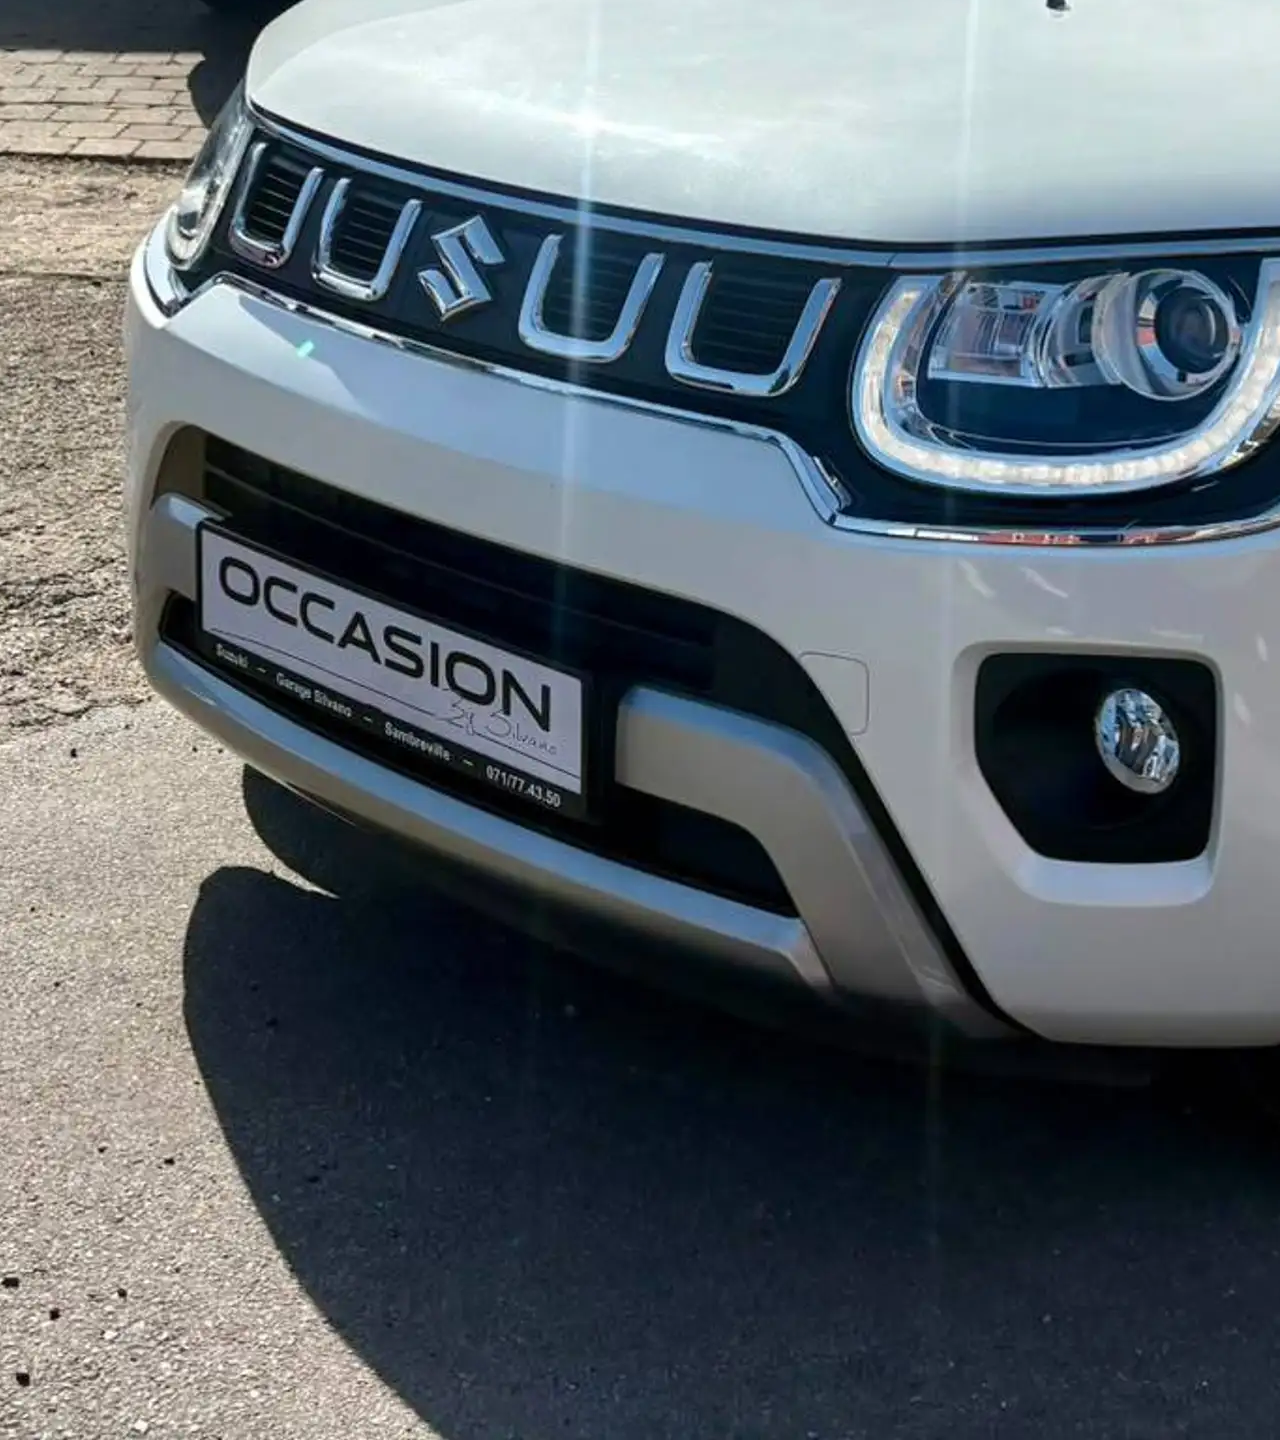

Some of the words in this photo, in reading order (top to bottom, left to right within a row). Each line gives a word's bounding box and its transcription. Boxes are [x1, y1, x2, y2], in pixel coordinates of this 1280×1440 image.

[220, 556, 551, 732] OCCASION
[276, 672, 312, 700] Garage
[314, 690, 353, 718] Silvano
[384, 720, 451, 761] Sambreville
